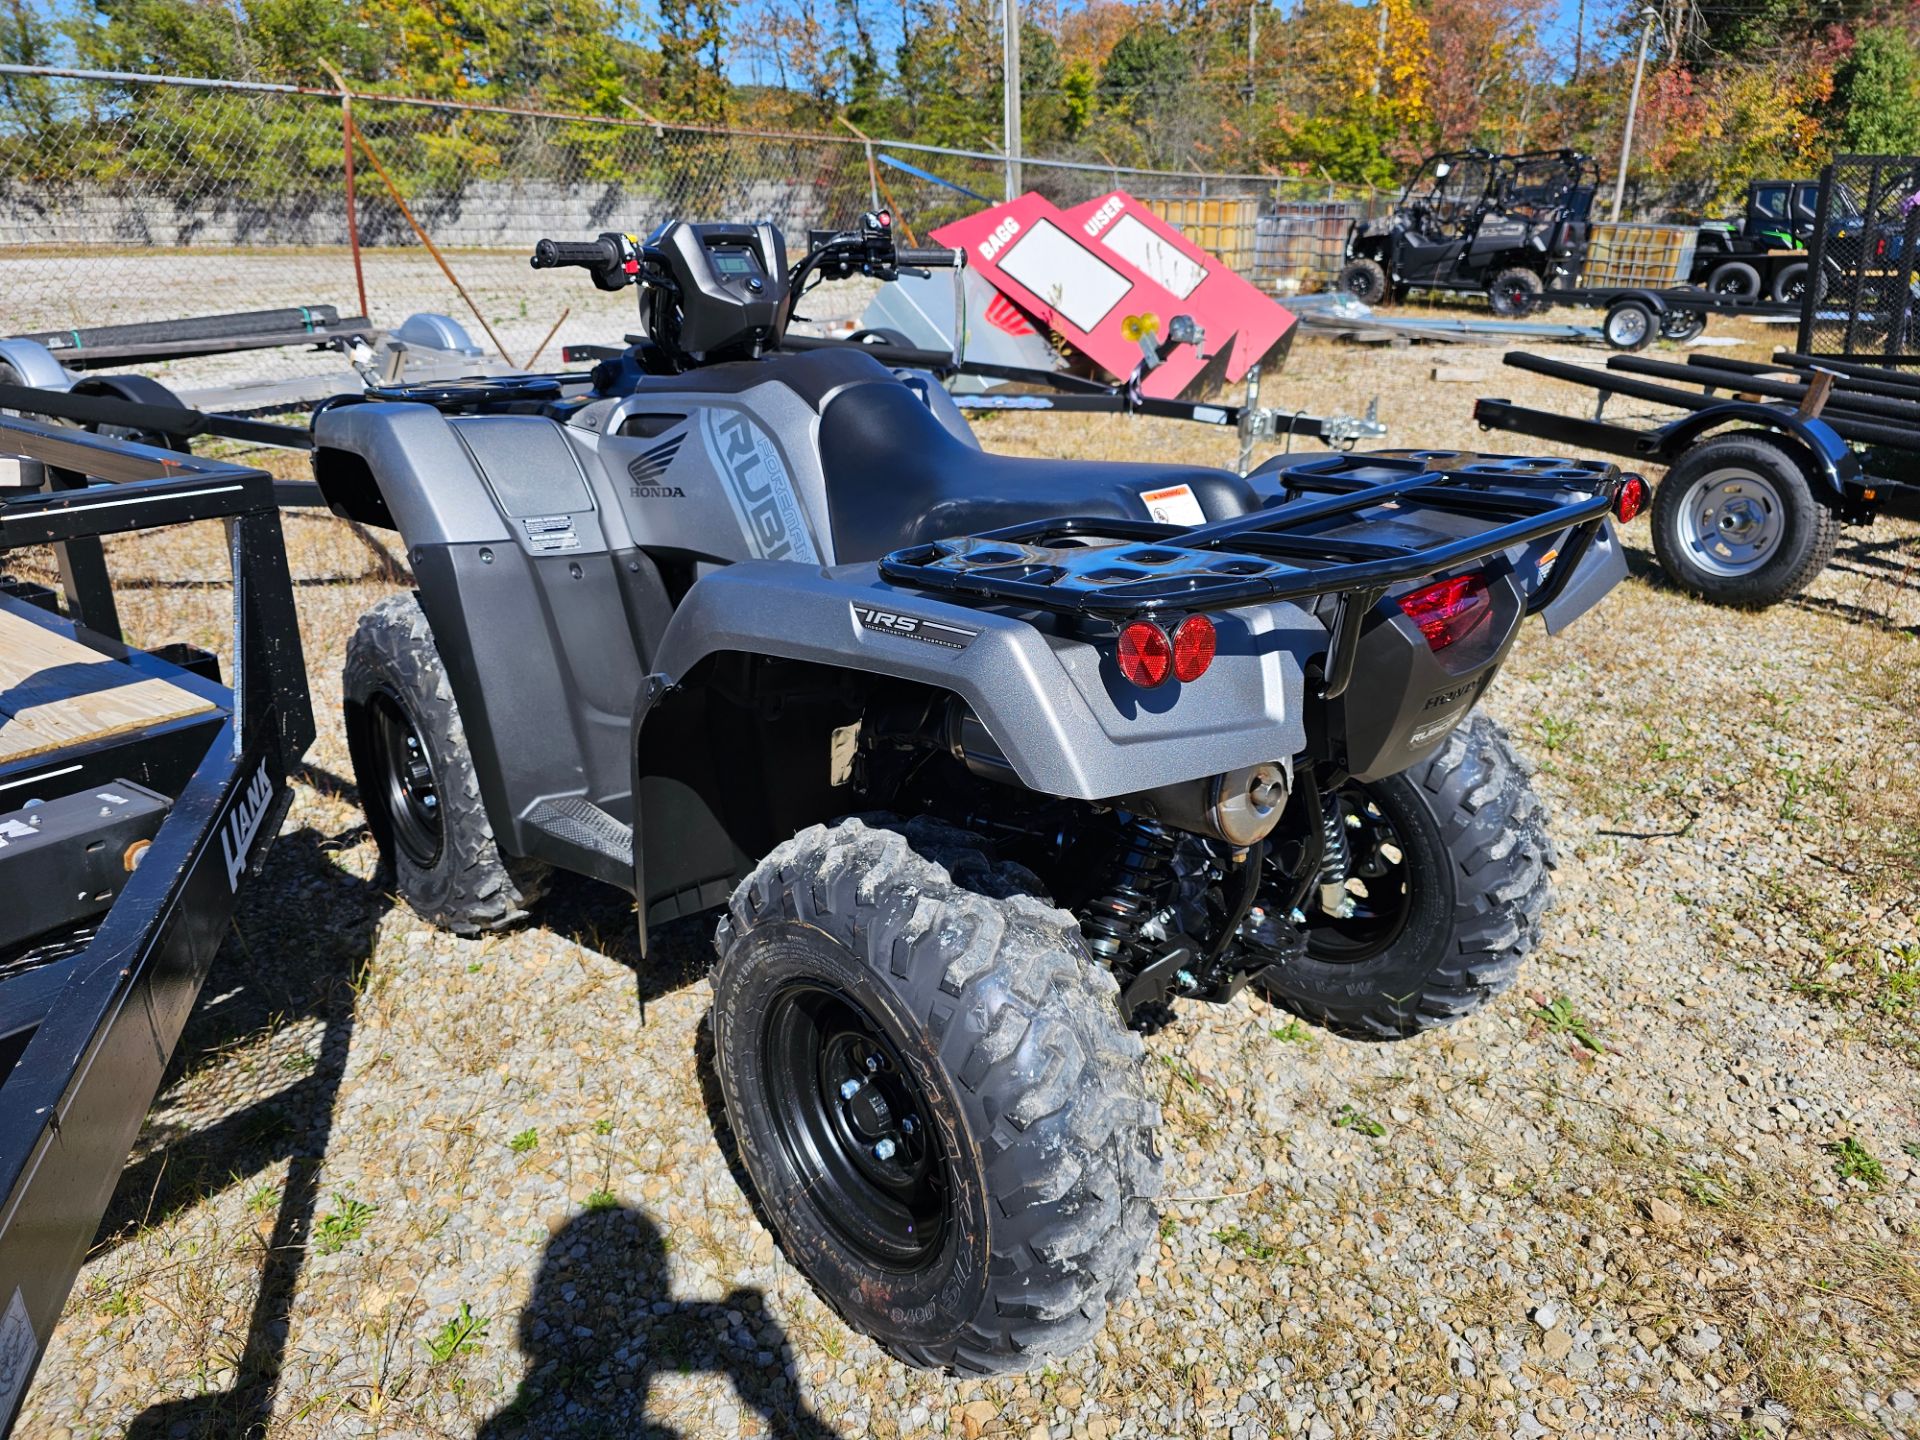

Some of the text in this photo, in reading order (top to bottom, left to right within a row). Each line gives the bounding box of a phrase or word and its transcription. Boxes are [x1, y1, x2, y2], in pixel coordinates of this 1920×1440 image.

[978, 216, 1021, 261] BAGG
[630, 487, 687, 498] HONDA
[758, 438, 814, 562] FOREMAN
[865, 610, 919, 632] IRS
[905, 1050, 974, 1308] MAXXIS
